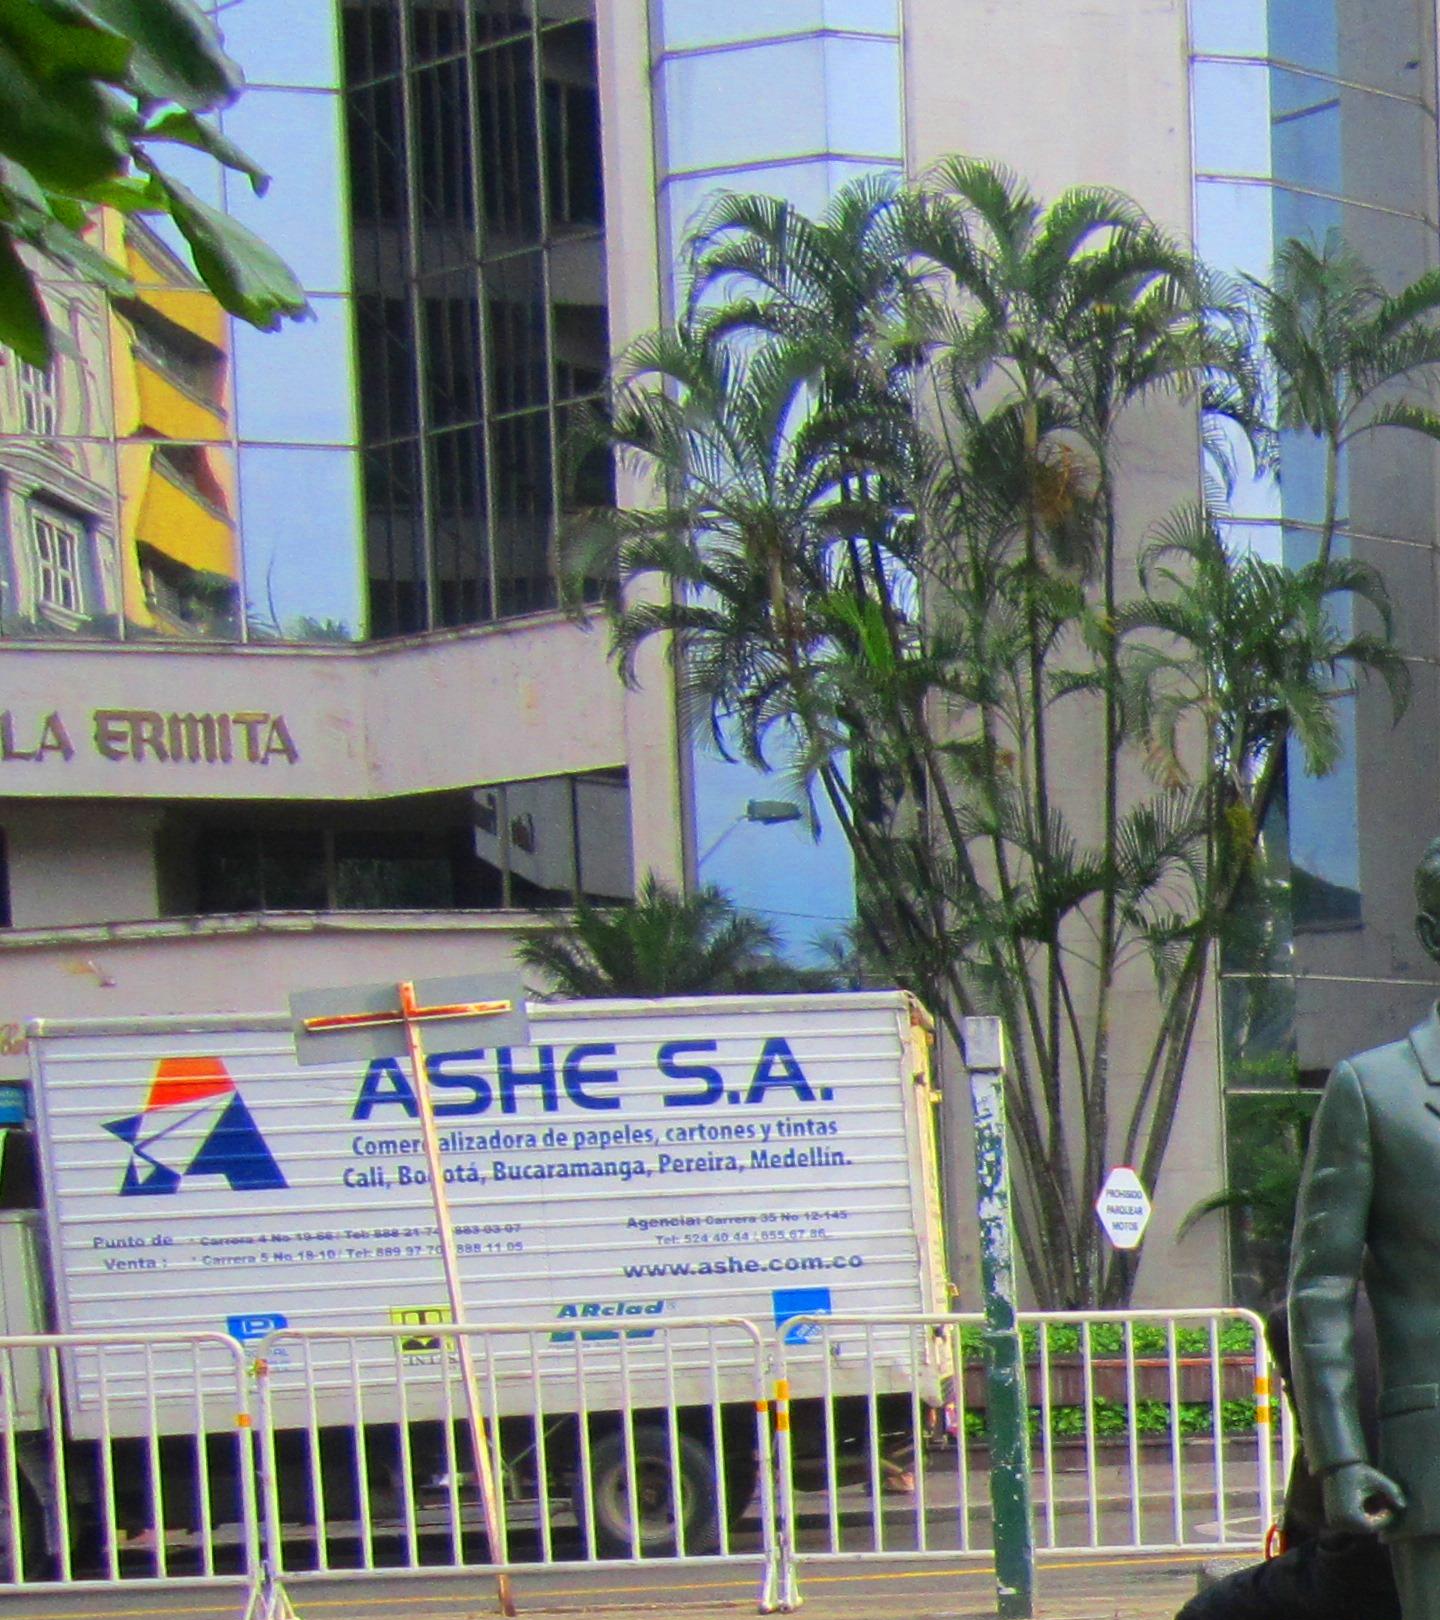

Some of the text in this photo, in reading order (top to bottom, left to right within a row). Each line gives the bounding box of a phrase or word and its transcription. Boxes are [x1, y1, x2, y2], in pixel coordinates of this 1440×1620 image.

[1, 709, 299, 764] LA ERMITA
[352, 1037, 835, 1120] ASHE S.A.
[353, 1116, 838, 1155] Comeralizadora de papeles, cartones y tintas
[343, 1166, 391, 1189] Cali,
[397, 1161, 486, 1187] Bootá,
[493, 1157, 652, 1181] Bucaramanga,
[658, 1152, 745, 1173] Pereira,
[93, 1236, 145, 1249] Punto
[152, 1234, 173, 1246] de
[202, 1255, 256, 1265] Carrera
[273, 1252, 292, 1262] No
[623, 1254, 863, 1278] www.ashe.com.co
